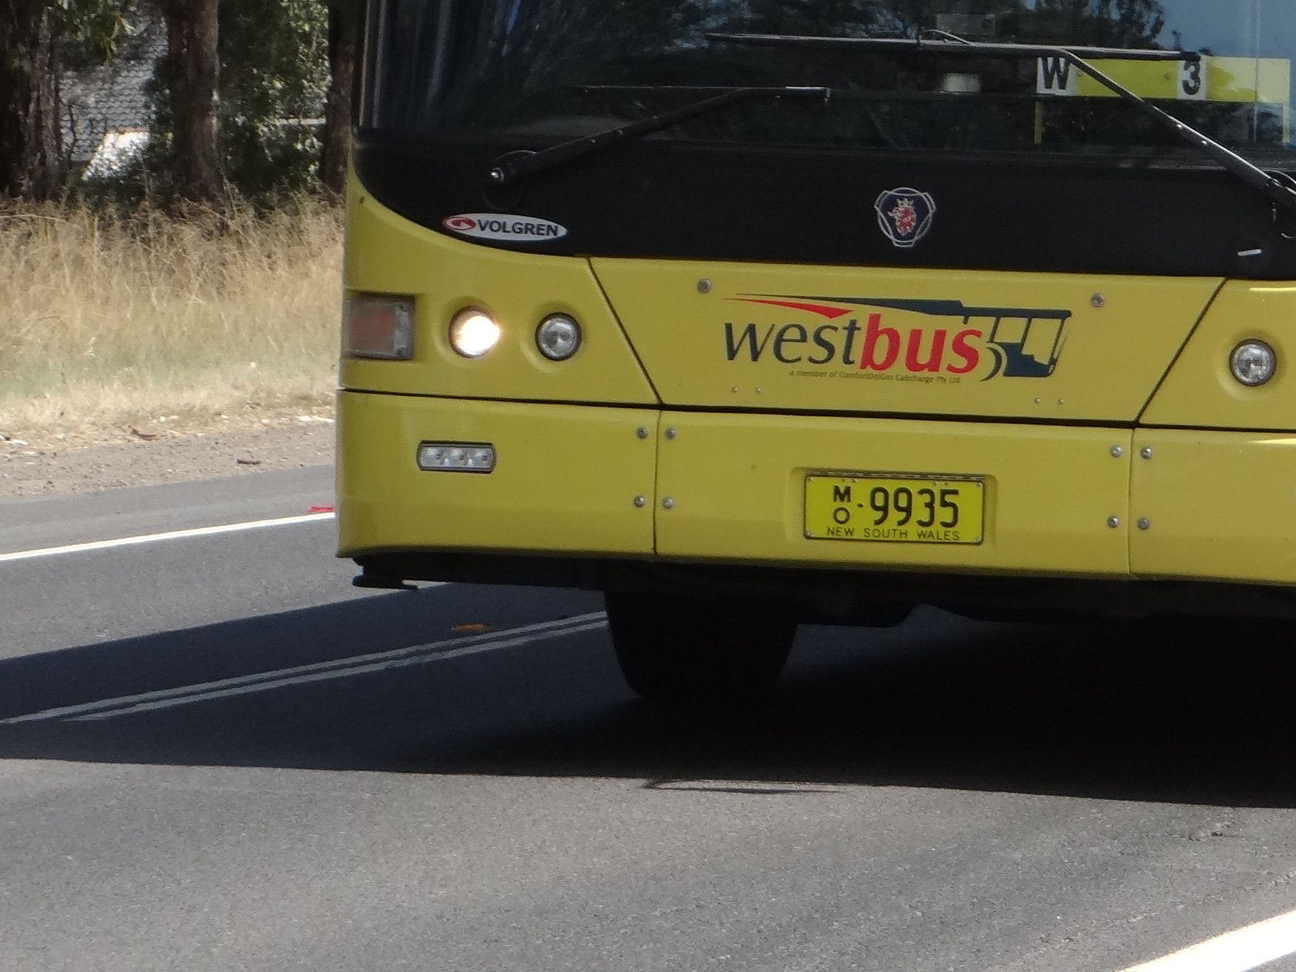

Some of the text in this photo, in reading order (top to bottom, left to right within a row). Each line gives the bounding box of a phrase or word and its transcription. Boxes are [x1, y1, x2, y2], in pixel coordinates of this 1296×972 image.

[1041, 57, 1200, 96] W 3
[477, 218, 560, 237] VOLGREN
[724, 313, 982, 373] westbus
[826, 526, 961, 541] NEW SOUTH WALES
